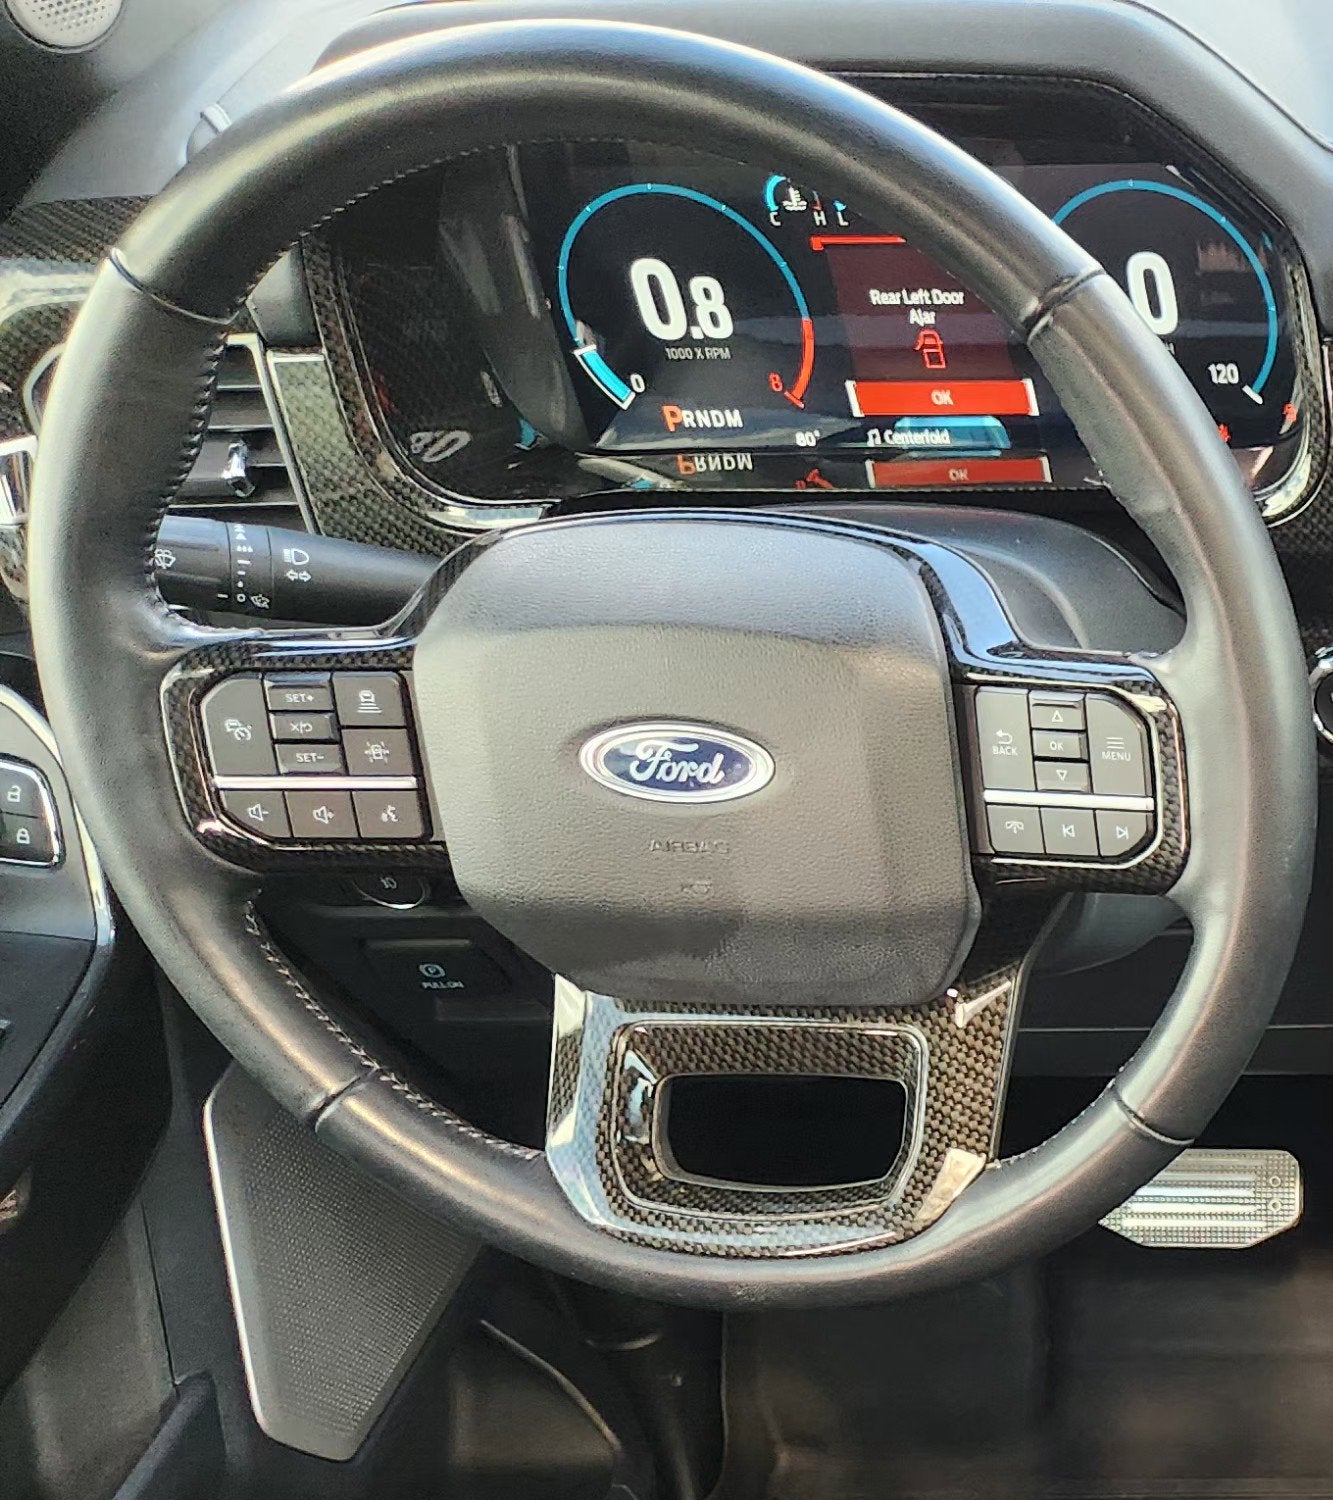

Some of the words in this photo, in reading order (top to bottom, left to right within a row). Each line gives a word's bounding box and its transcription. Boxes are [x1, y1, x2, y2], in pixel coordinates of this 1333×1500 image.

[768, 210, 781, 226] C
[813, 211, 826, 226] H
[630, 257, 734, 341] 0.8
[869, 288, 902, 305] Rear
[903, 288, 931, 305] Left
[932, 288, 965, 305] Door
[1126, 251, 1179, 335] 0
[909, 308, 936, 327] Ajar
[665, 347, 693, 360] 1000
[694, 347, 705, 360] X
[706, 347, 731, 360] RPM
[630, 373, 645, 393] 0
[768, 372, 783, 392] 8
[1207, 363, 1239, 385] 120
[931, 390, 954, 406] OK
[661, 405, 744, 432] PRNDM
[883, 428, 950, 446] Centerfold
[992, 745, 1018, 756] BACK
[1049, 740, 1064, 751] OK
[628, 739, 725, 785] Ford
[1101, 750, 1132, 762] MENU
